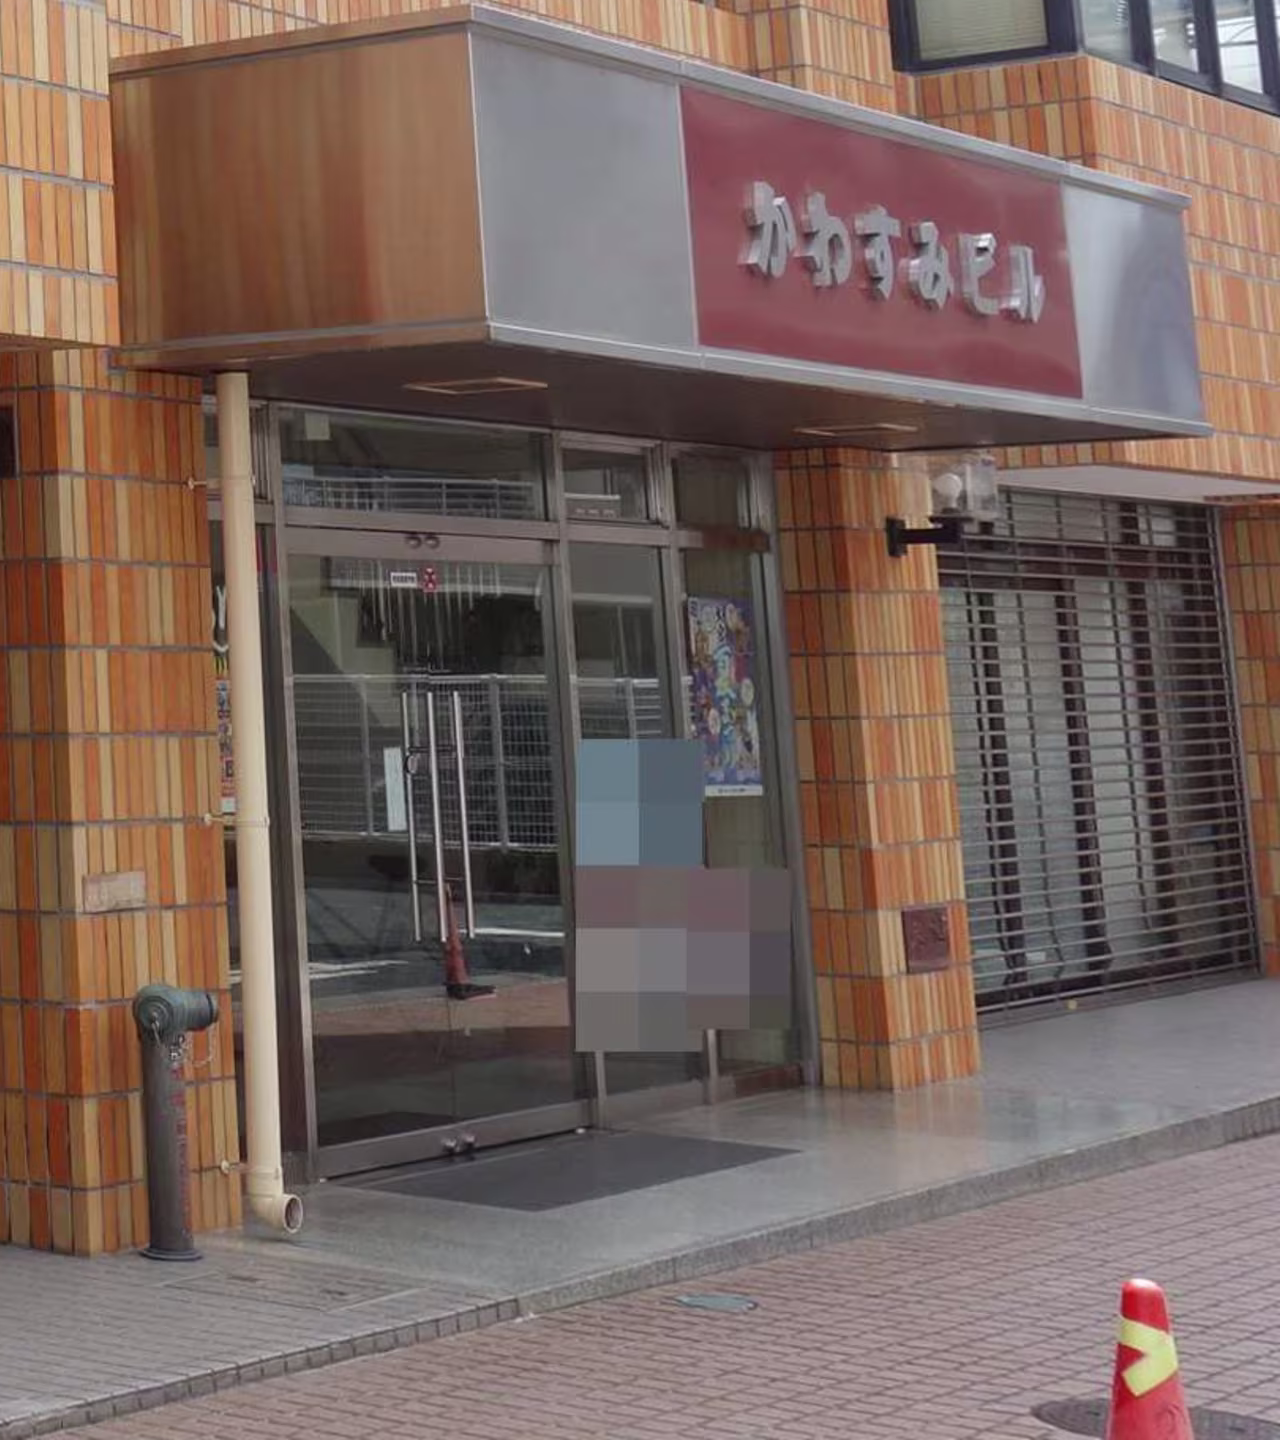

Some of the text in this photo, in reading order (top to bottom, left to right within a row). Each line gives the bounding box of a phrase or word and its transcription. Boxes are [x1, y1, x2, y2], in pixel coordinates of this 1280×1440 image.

[737, 180, 1047, 324] かわすみビル
